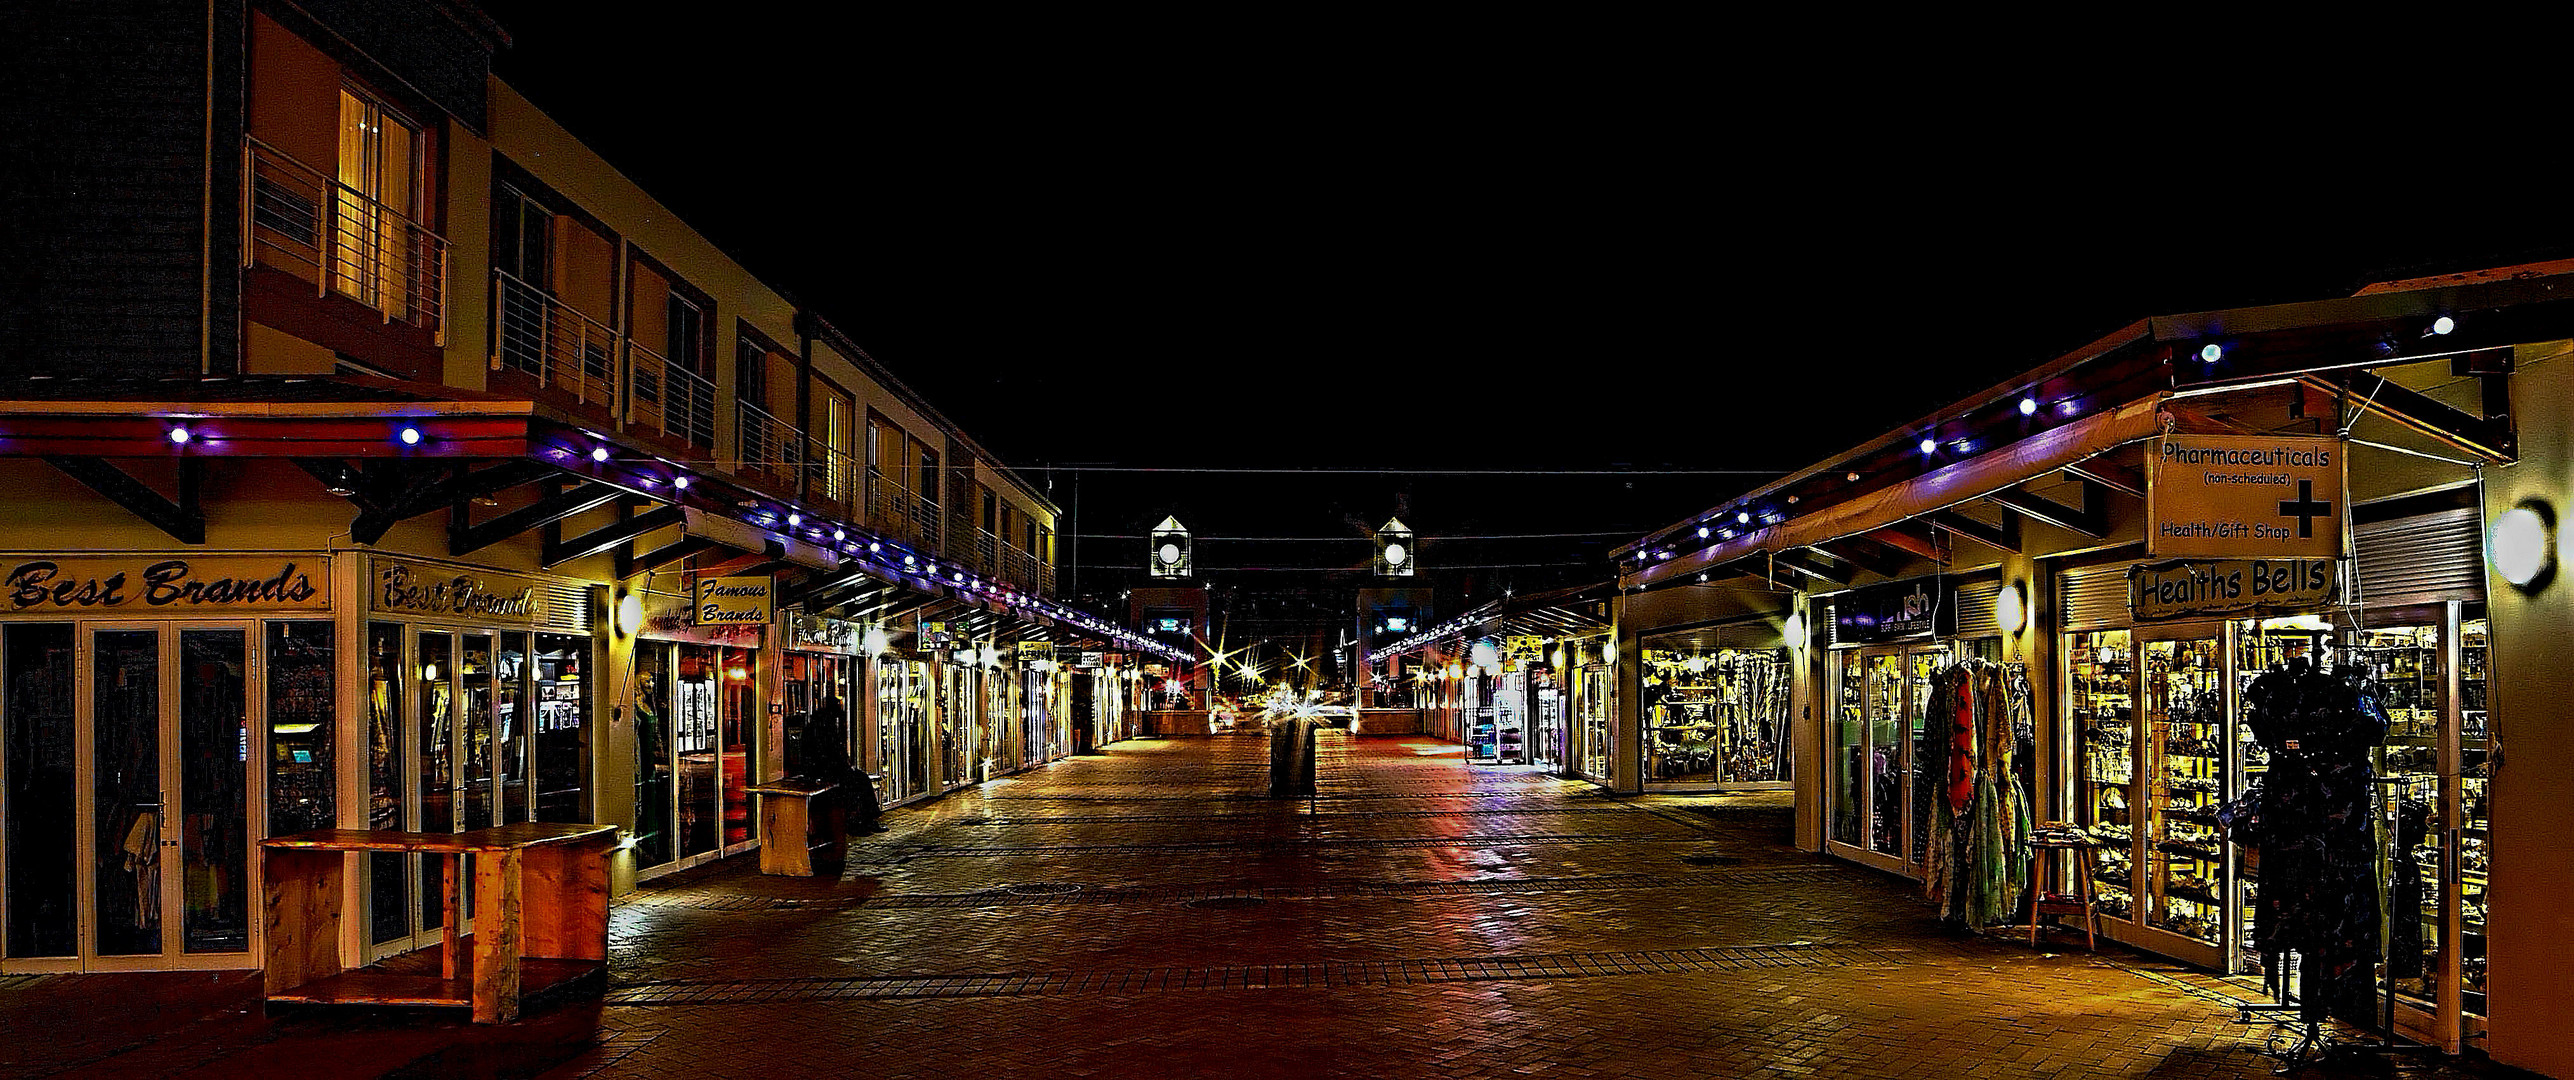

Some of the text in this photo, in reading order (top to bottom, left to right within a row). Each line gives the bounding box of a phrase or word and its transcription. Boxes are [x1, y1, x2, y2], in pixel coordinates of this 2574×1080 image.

[2161, 442, 2330, 467] Pharmaceuticals
[2204, 471, 2291, 486] (non-scheduled)
[2160, 521, 2290, 543] Health/Gift Shop
[5, 560, 316, 611] Best Brands
[382, 564, 447, 613] Best
[701, 578, 768, 600] Famous
[2141, 560, 2326, 607] Healths Bells
[702, 603, 764, 621] Brands
